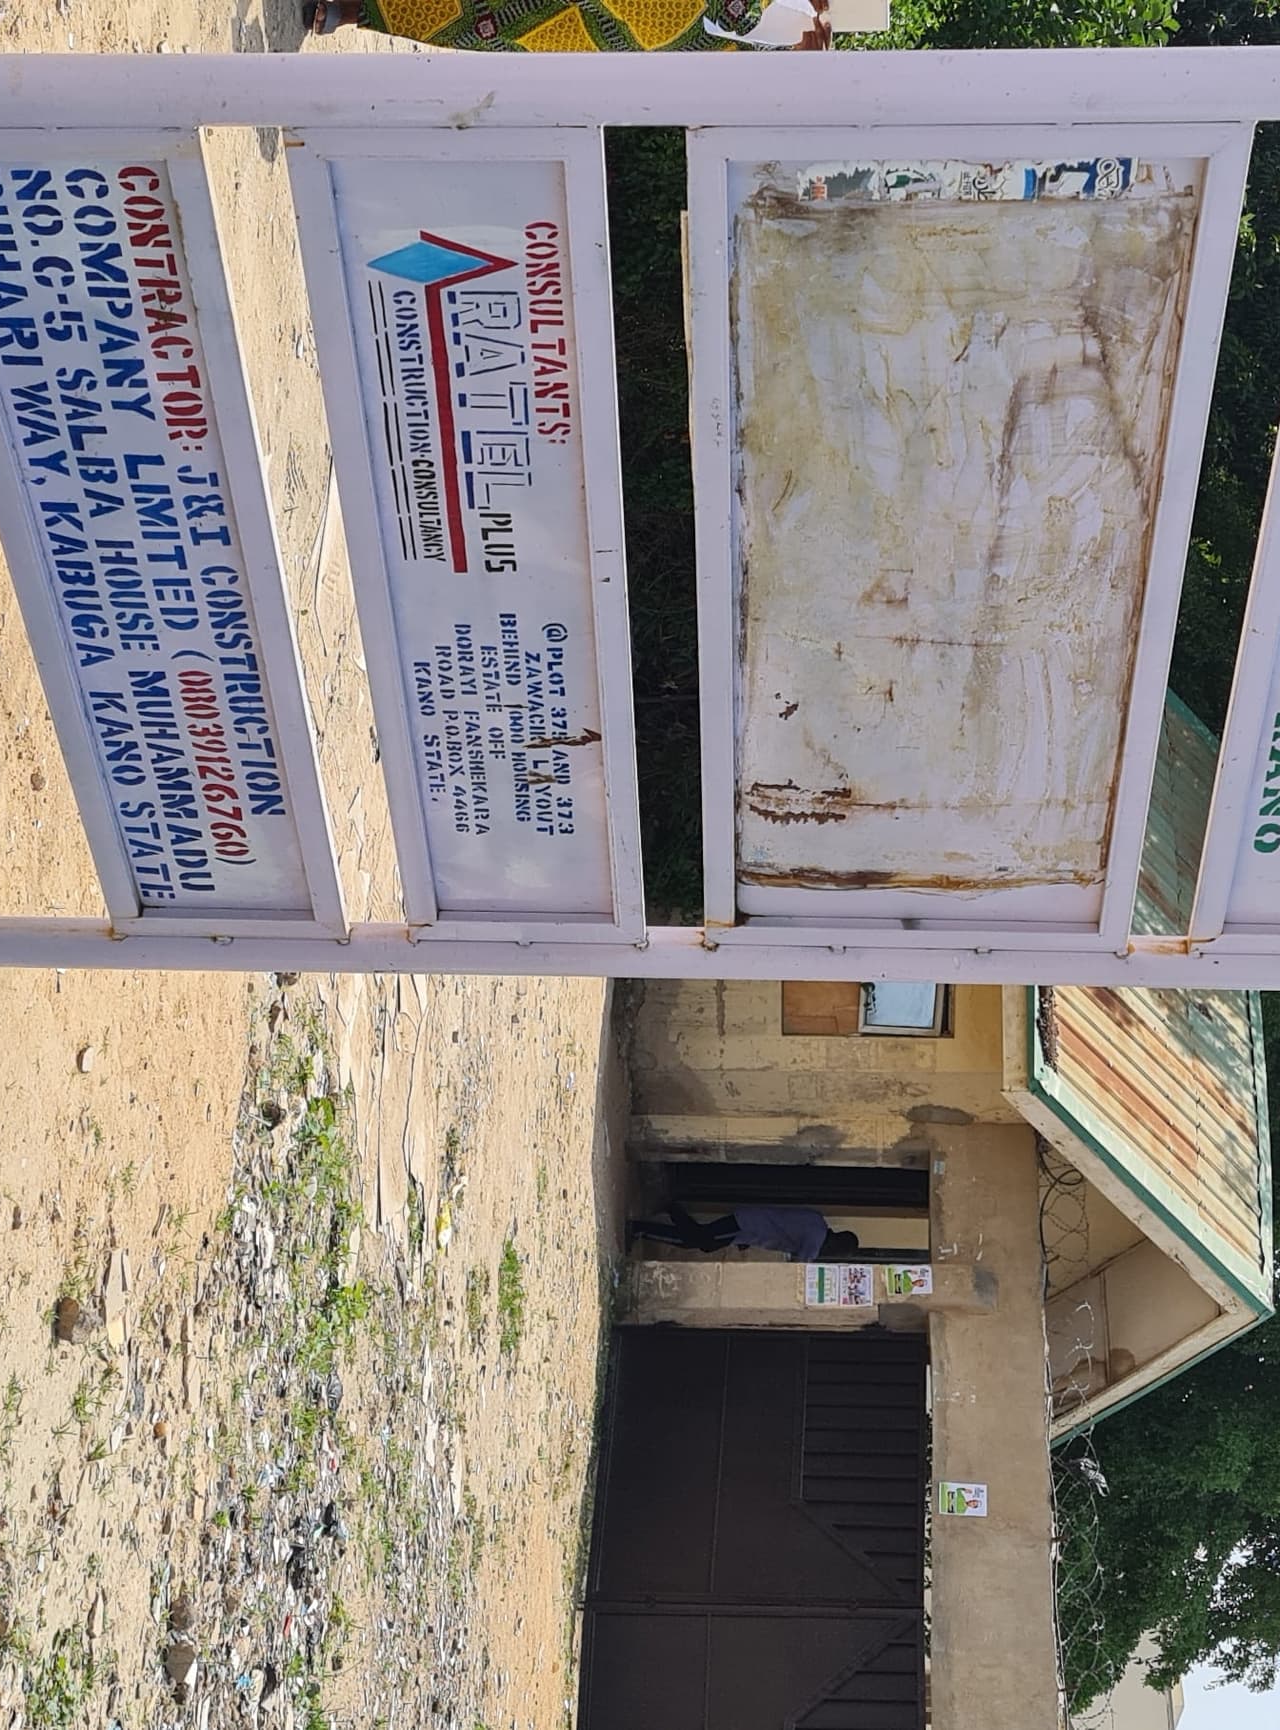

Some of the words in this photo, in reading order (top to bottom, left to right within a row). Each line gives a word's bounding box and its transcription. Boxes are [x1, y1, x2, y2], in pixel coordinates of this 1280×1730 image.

[117, 166, 208, 451] CONTRACTOR:
[524, 221, 571, 444] CONSULTANTS:
[11, 381, 70, 486] WAY,
[55, 367, 125, 518] SALBA
[65, 169, 156, 421] COMPANY
[123, 453, 200, 631] LIMITED
[447, 290, 532, 510] RATEL
[177, 465, 232, 547] J&I
[479, 513, 517, 572] PLUS
[40, 502, 115, 667] KABUGA
[94, 540, 161, 651] HOUSE
[199, 565, 286, 816] CONSTRUCTION
[414, 662, 435, 716] KANO
[454, 624, 477, 695] DORAYI
[480, 646, 502, 712] ESTATE
[88, 691, 146, 786] KANO
[435, 646, 455, 699] ROAD
[452, 785, 470, 833] 4466
[464, 711, 490, 835] FANSHEKARA
[488, 727, 505, 759] OFF
[499, 613, 521, 686] BEHIND
[511, 752, 531, 822] HOUSING
[552, 749, 571, 784] AND
[127, 671, 216, 891] MUHAMMADU
[556, 797, 575, 834] 373
[119, 801, 176, 899] STATE
